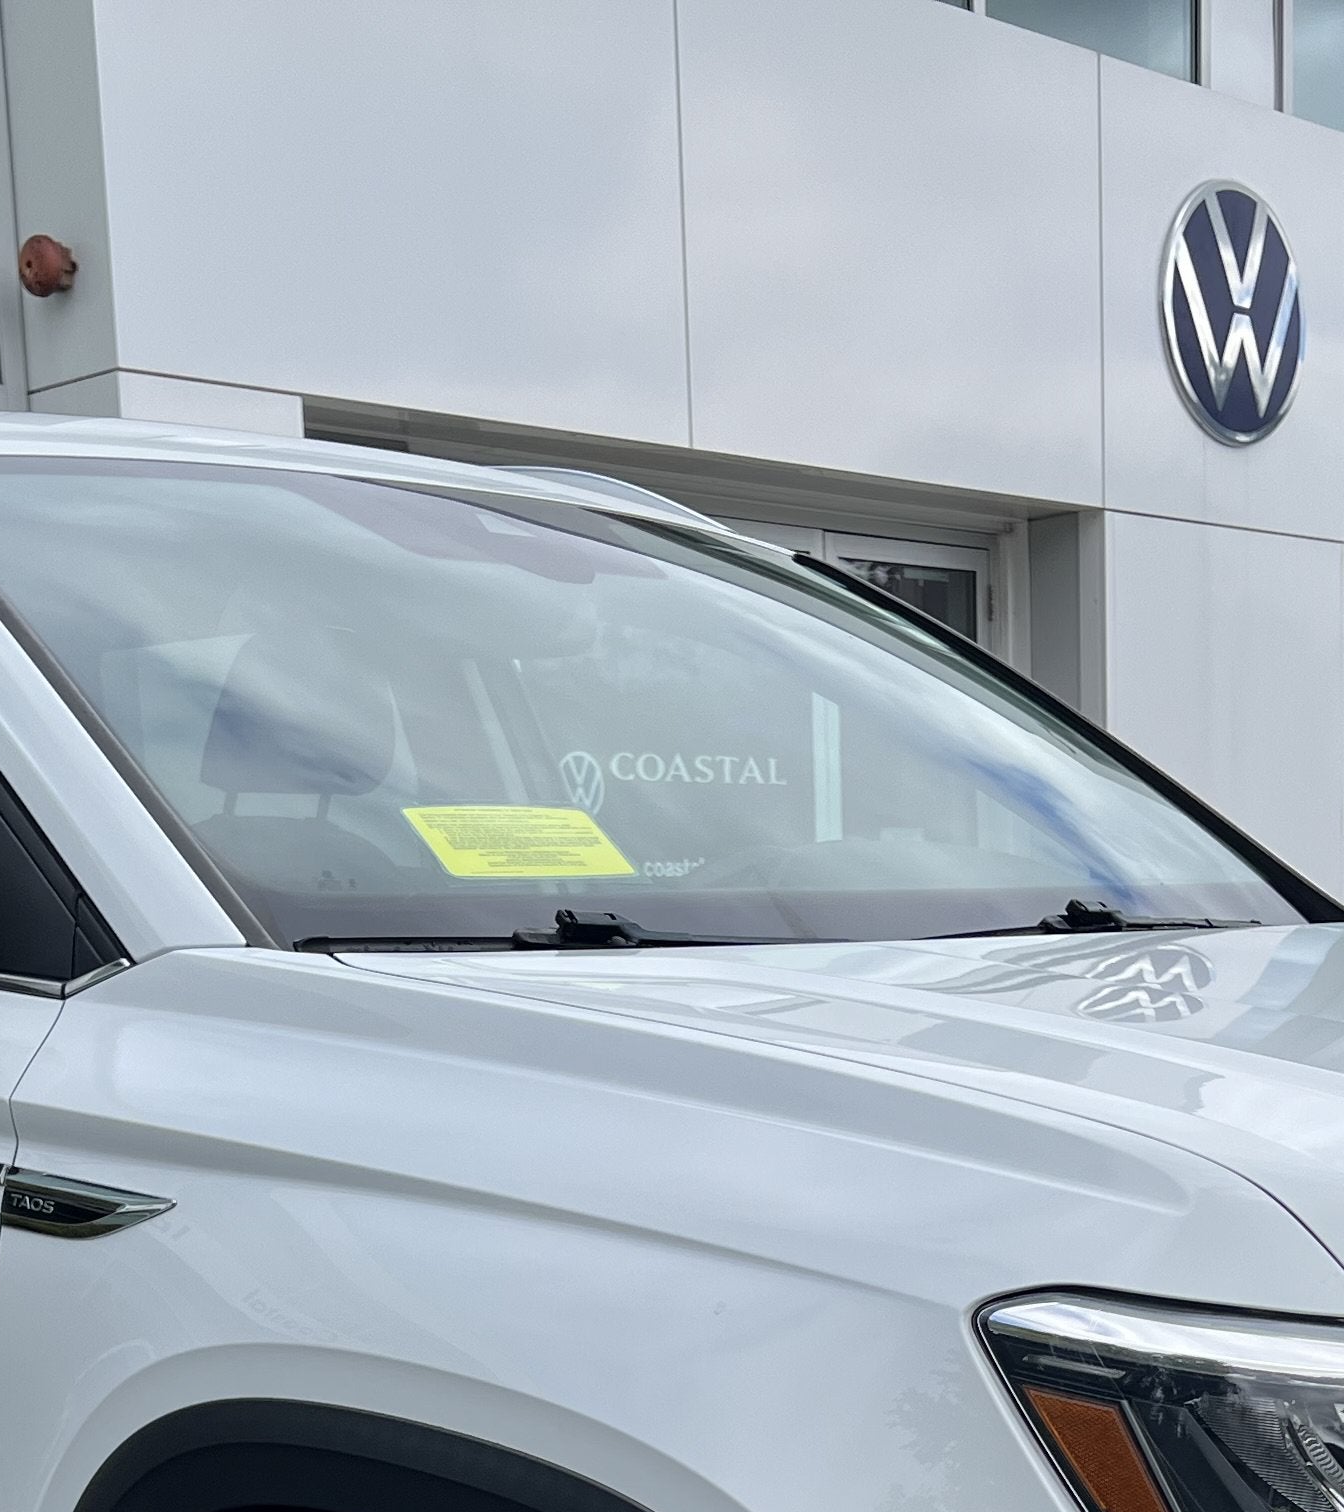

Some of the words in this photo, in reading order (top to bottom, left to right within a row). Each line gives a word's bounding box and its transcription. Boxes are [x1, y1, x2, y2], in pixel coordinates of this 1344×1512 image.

[1162, 182, 1304, 442] VW
[609, 752, 787, 785] COASTAL
[10, 1193, 55, 1214] TAOS
